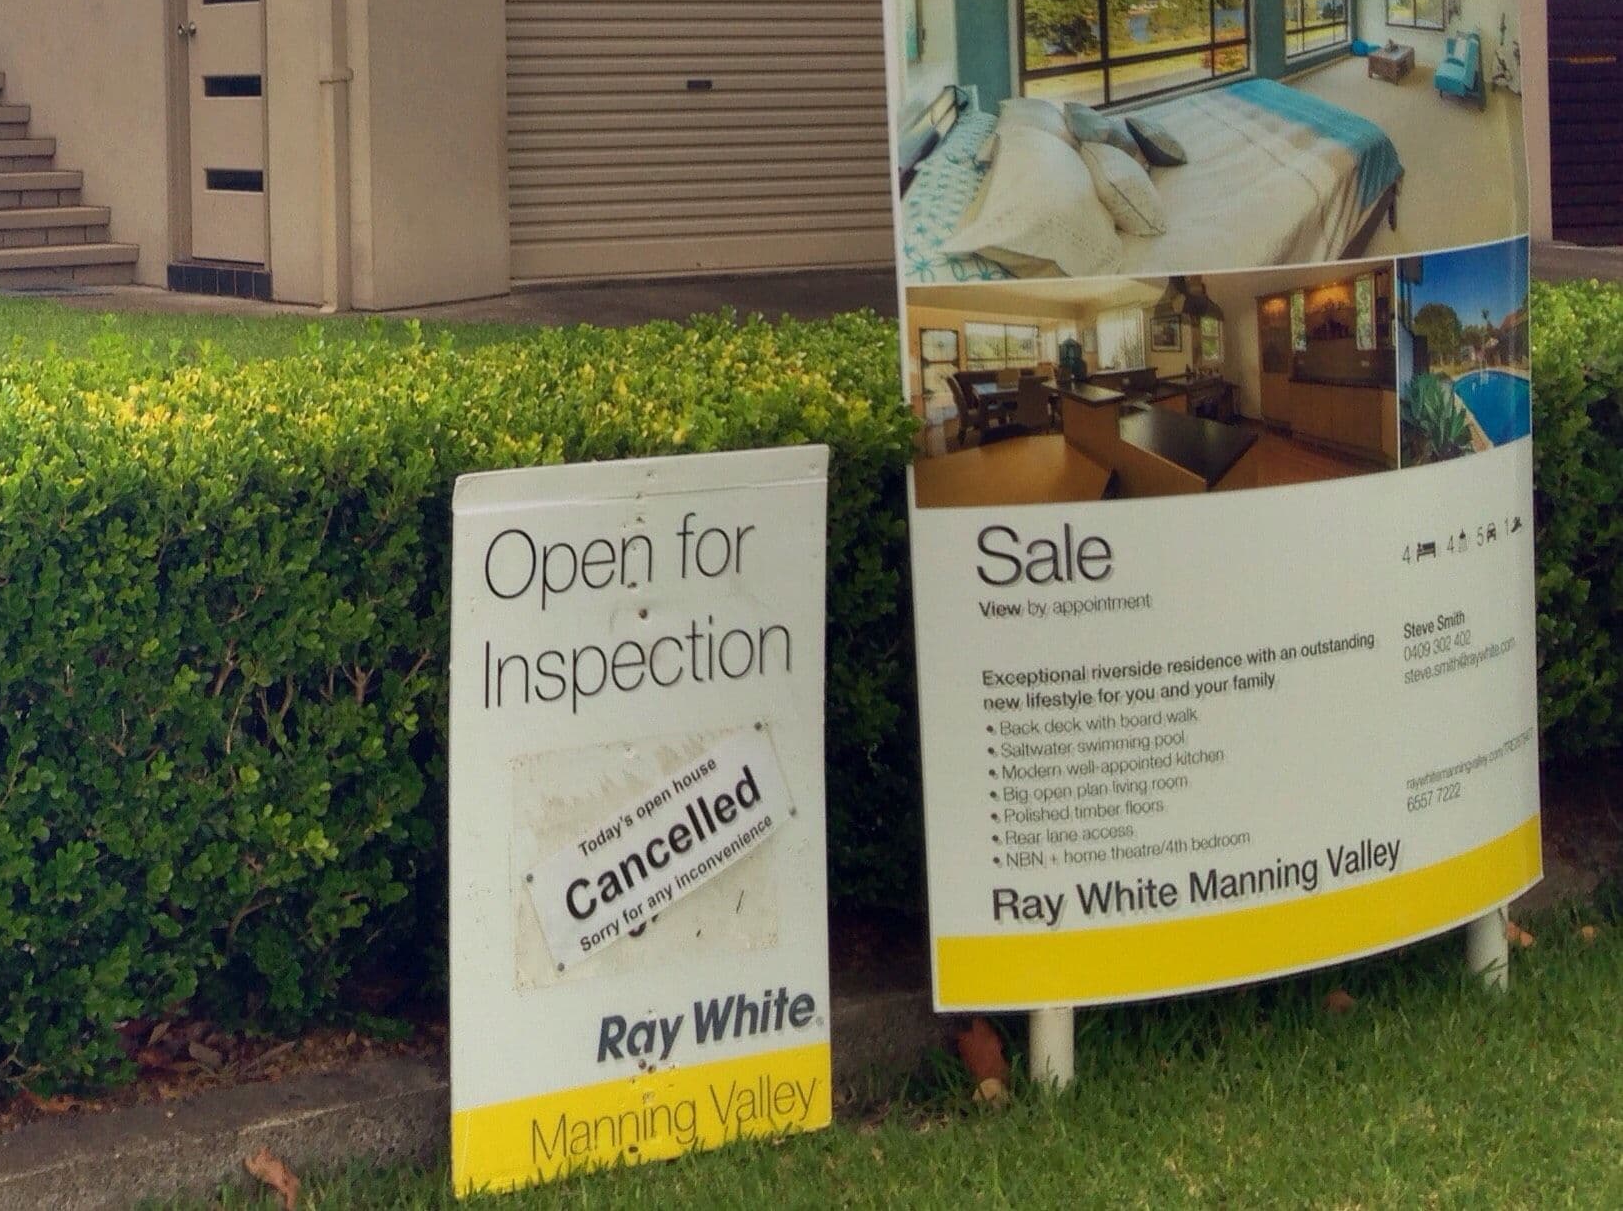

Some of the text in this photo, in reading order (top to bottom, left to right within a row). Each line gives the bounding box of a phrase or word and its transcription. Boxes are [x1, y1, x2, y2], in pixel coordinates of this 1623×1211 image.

[485, 512, 755, 610] Open for
[977, 523, 1112, 585] Sale
[1402, 545, 1410, 564] 4
[1447, 535, 1454, 553] 4
[1477, 526, 1484, 546] 5
[979, 594, 1151, 617] View by appointment
[1404, 611, 1465, 639] Steve Smith
[485, 615, 791, 714] Inspection
[982, 632, 1375, 686] Exceptional riverside residence with an outstanding
[1404, 642, 1430, 661] 0409
[983, 672, 1275, 710] new lifestyle for you and your family
[1000, 707, 1197, 736] Back deck with board walk
[1001, 730, 1185, 758] Saltwater swimming pool
[1001, 748, 1224, 780] Modern well-appointed kitchen
[577, 757, 717, 858] Today's open house
[1003, 775, 1188, 804] Big open plan living room
[1004, 799, 1164, 823] Polished timber floors
[565, 764, 762, 921] Cancelled
[1005, 824, 1133, 845] Rear lane access
[1006, 851, 1043, 868] NBN
[1064, 847, 1106, 864] home
[1111, 835, 1187, 859] theatre/4th
[1192, 831, 1250, 852] bedroom
[580, 920, 620, 952] Sorry
[623, 904, 643, 927] for
[648, 884, 672, 910] any
[674, 815, 772, 890] inconvenience
[992, 839, 1401, 926] Ray White Manning Valley
[597, 987, 815, 1063] Ray White
[533, 1074, 817, 1164] Manning Valley
